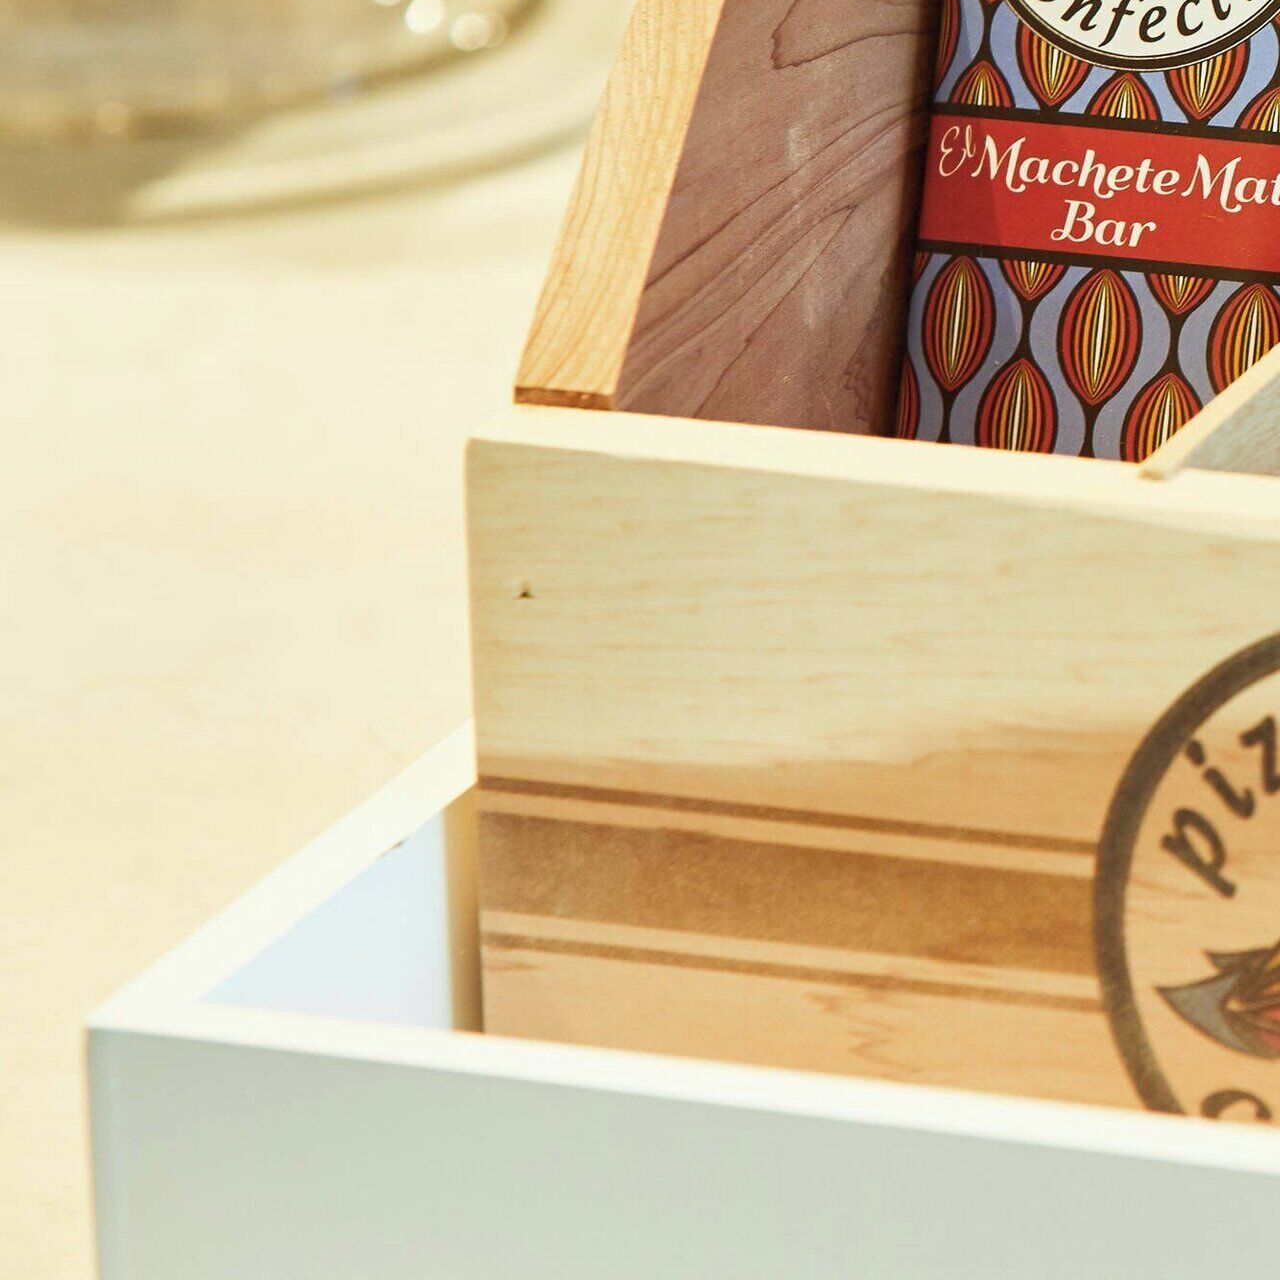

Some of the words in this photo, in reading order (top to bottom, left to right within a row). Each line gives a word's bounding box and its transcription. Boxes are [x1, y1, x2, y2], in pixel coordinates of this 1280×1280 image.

[940, 126, 977, 177] El
[972, 136, 1180, 196] Machete
[1051, 200, 1157, 250] Bar
